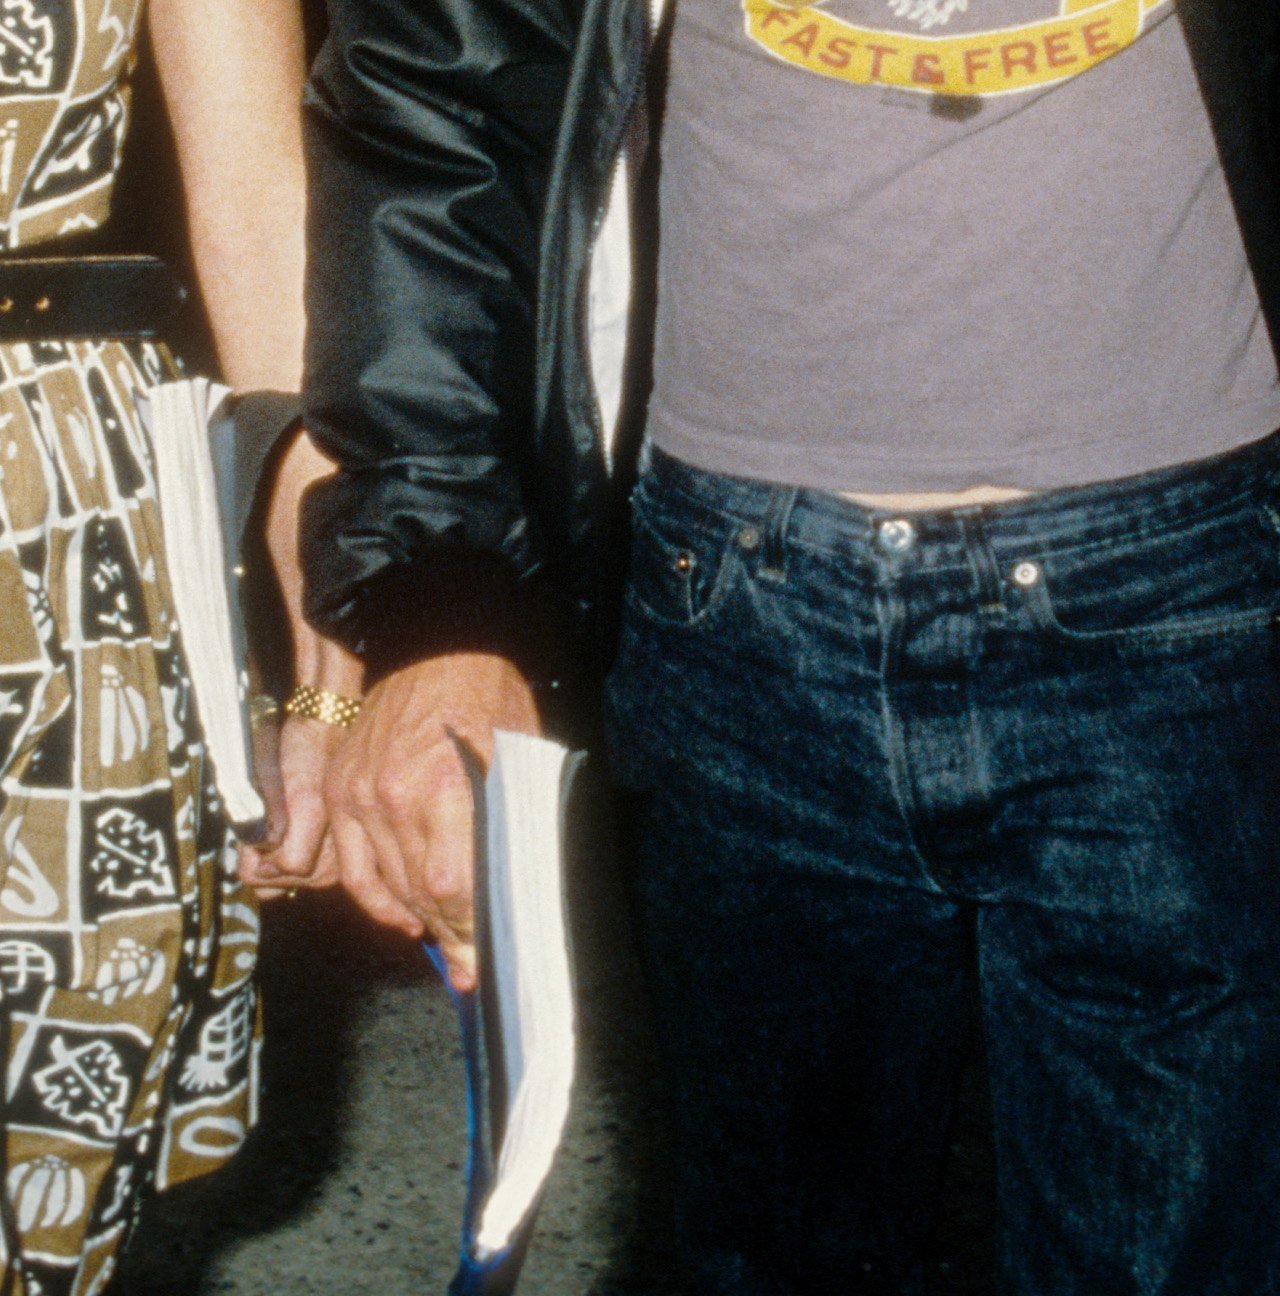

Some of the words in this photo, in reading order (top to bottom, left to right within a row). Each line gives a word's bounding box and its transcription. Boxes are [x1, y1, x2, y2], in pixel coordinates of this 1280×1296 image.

[761, 7, 899, 80] FAST
[911, 53, 946, 85] &
[962, 16, 1120, 84] FREE
